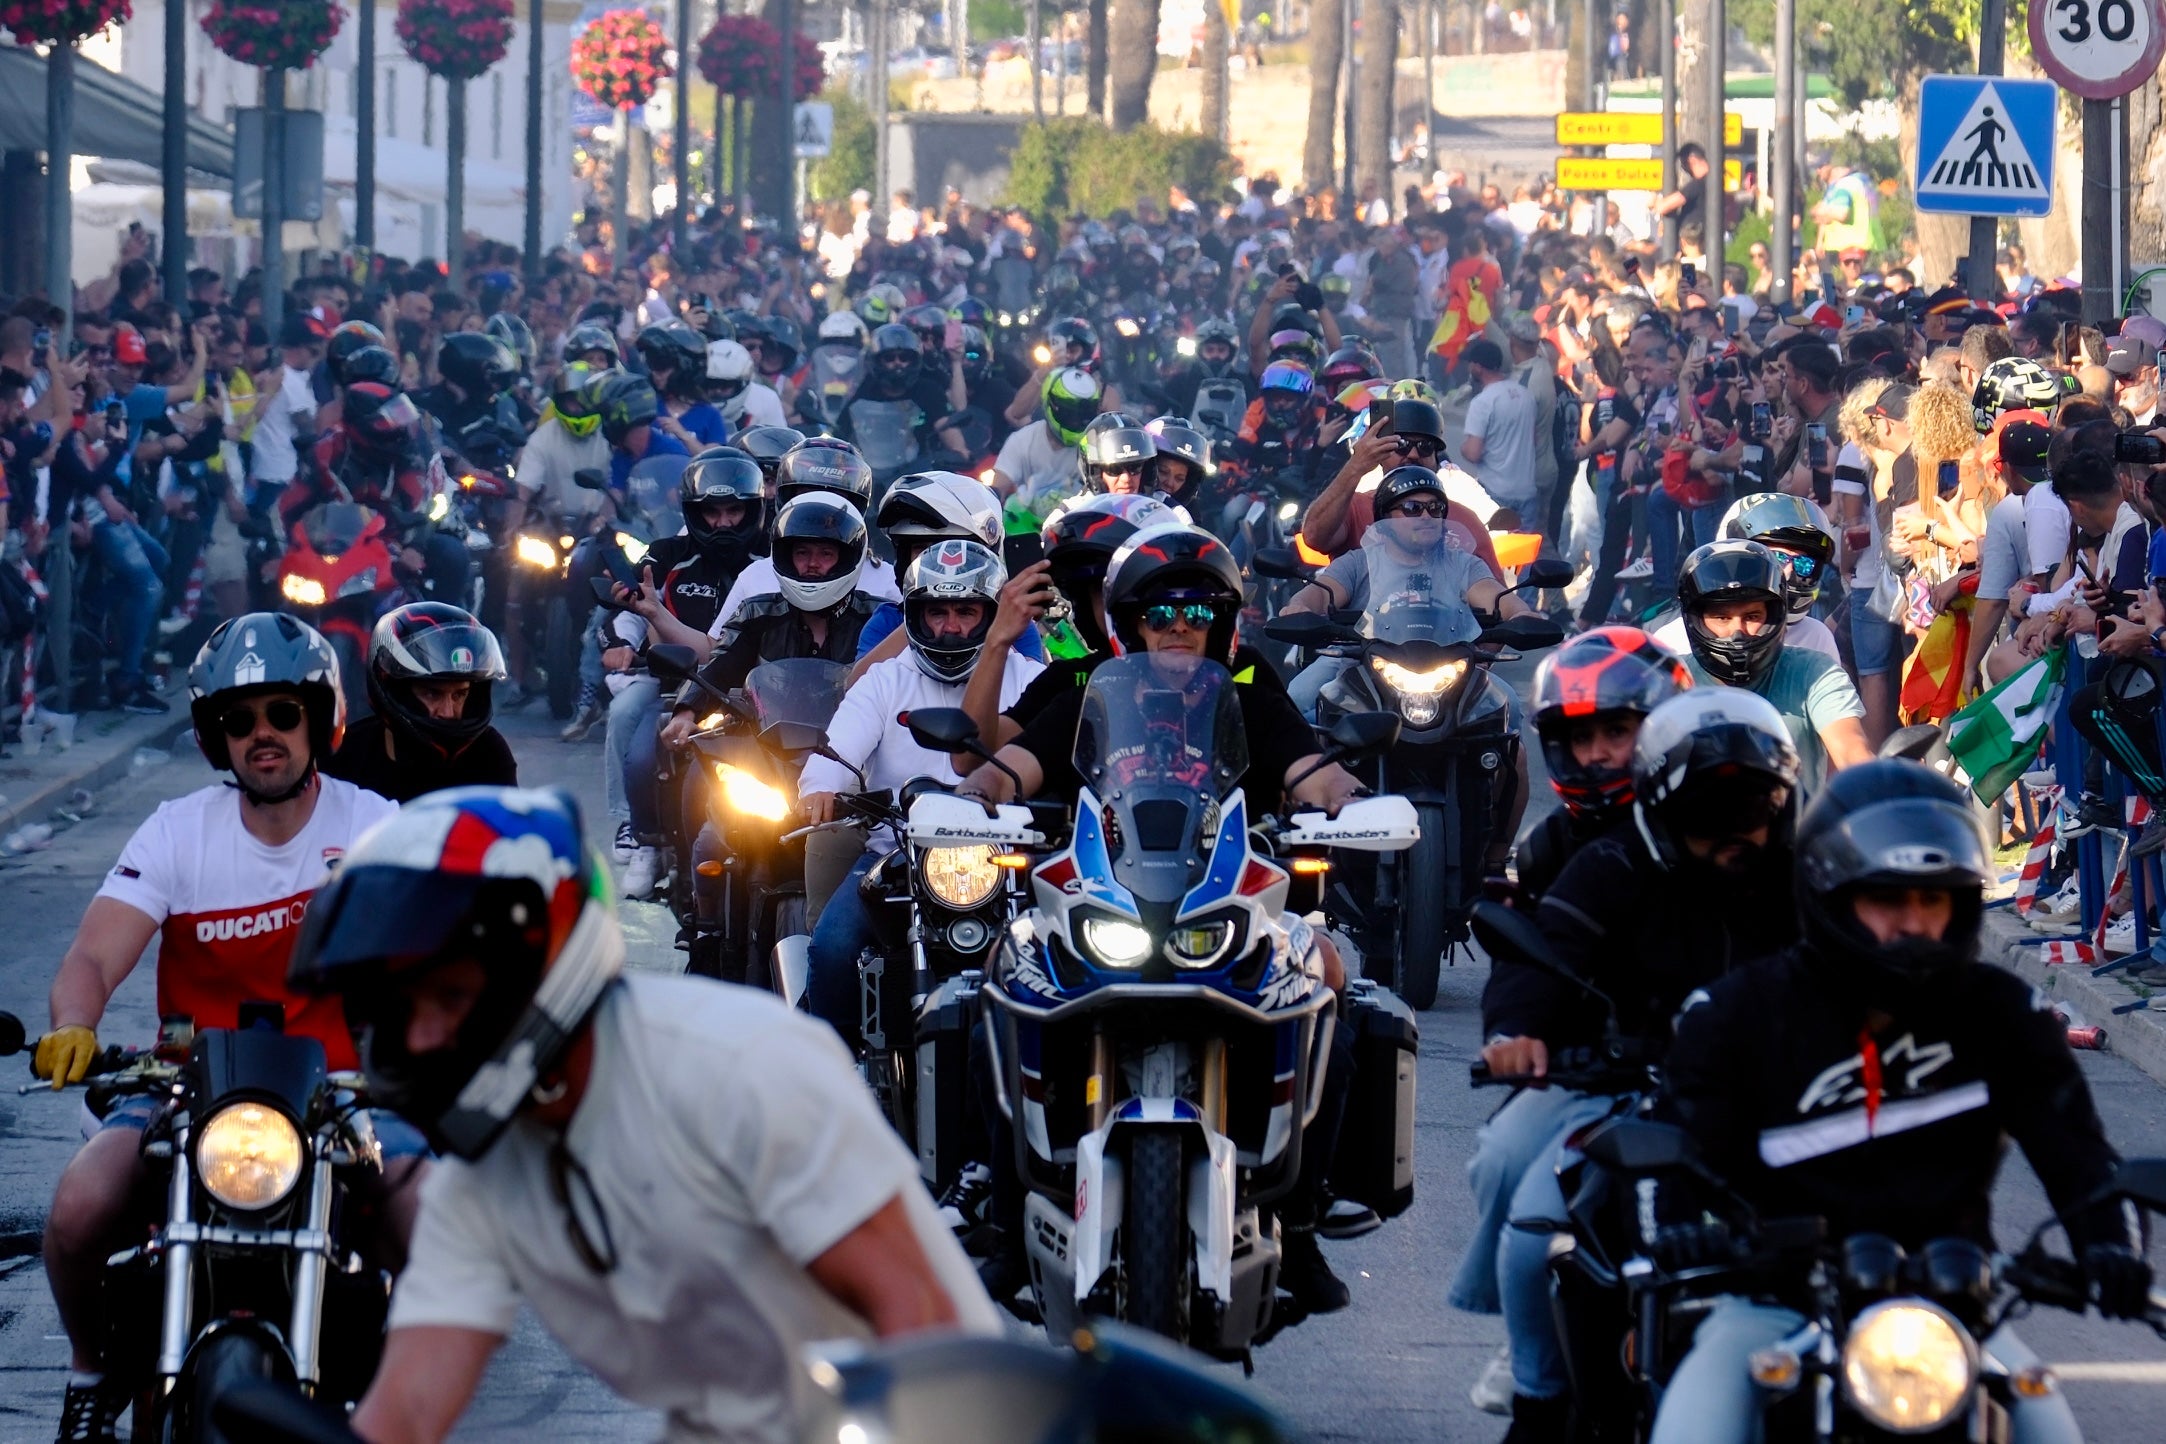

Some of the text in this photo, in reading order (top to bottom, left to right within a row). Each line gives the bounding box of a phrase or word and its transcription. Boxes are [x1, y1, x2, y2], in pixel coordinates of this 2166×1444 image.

[2056, 0, 2135, 43] 30
[808, 466, 846, 480] NOLAN
[934, 827, 1012, 840] Barkbusters
[1313, 830, 1391, 840] Barkbusters
